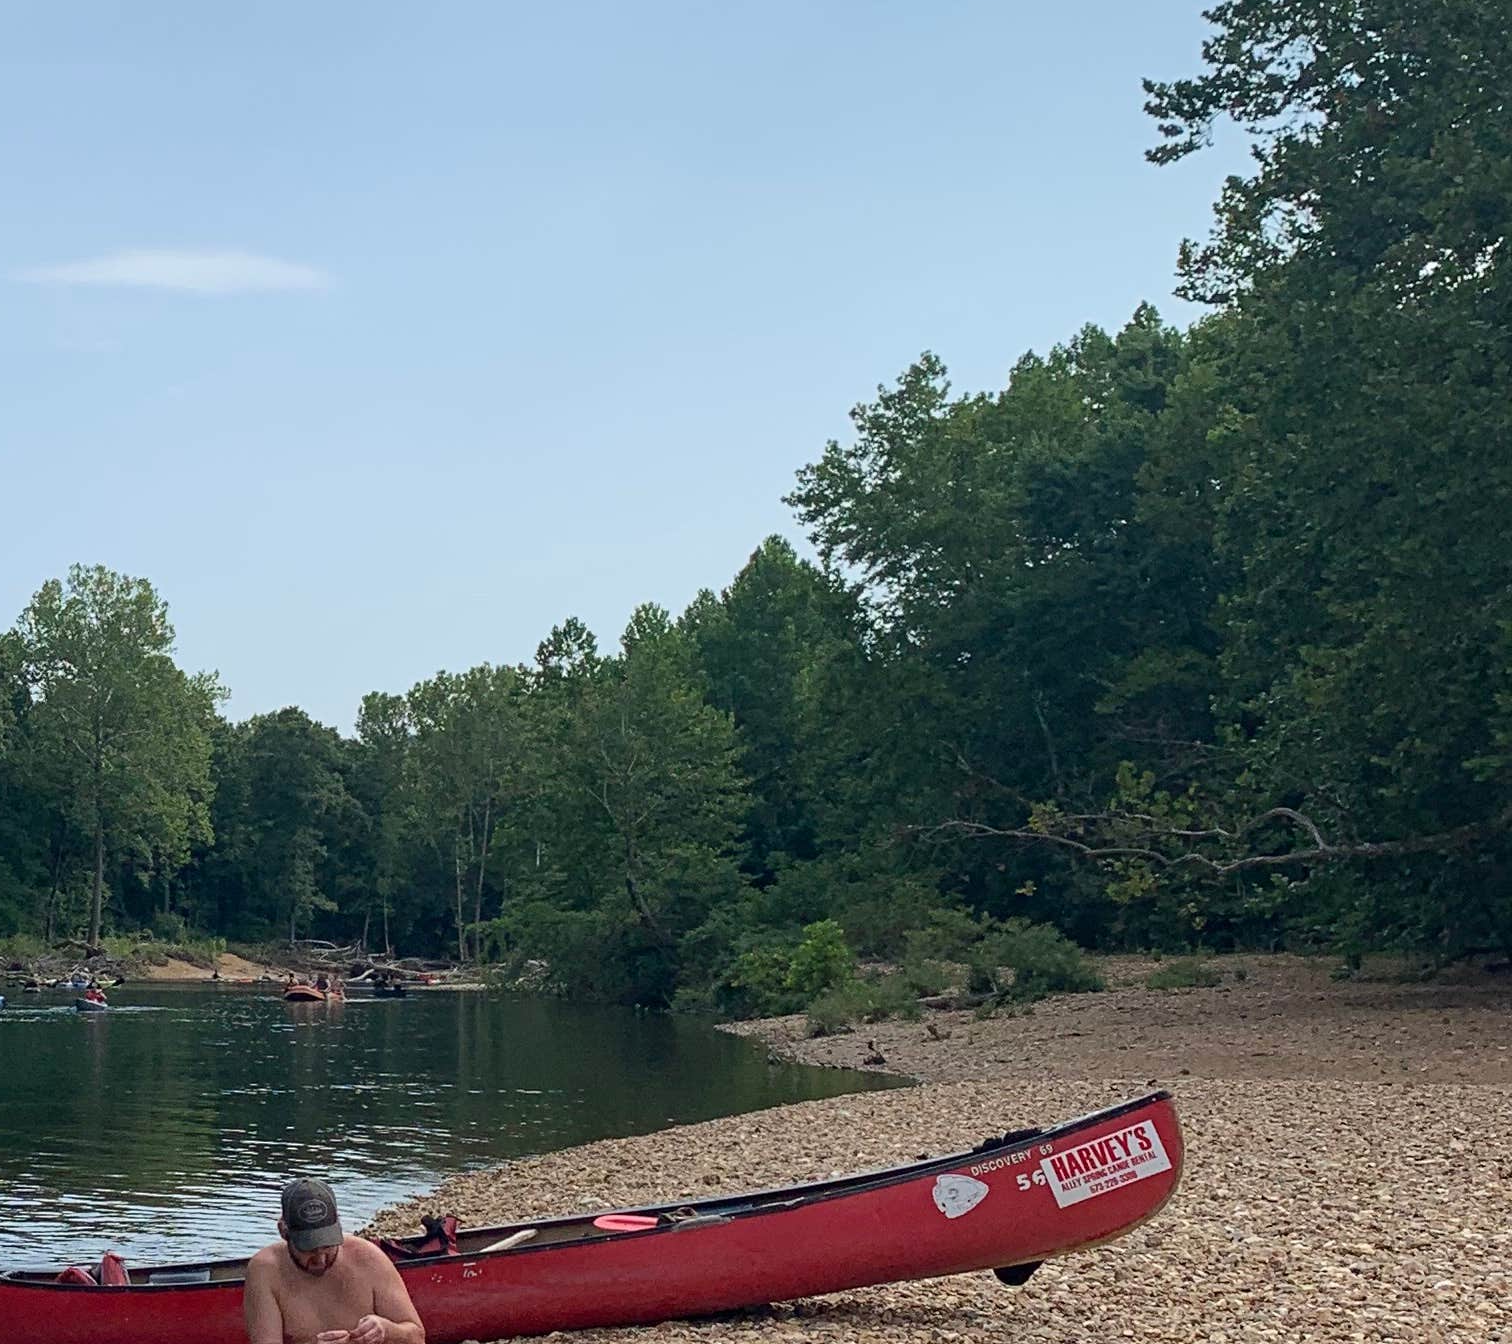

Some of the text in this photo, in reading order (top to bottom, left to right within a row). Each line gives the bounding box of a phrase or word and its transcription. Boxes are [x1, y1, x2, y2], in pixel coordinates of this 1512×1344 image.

[971, 1150, 1031, 1176] DISCOVERY
[1050, 1127, 1152, 1182] HARVEY'S
[1061, 1178, 1081, 1192] ALLEY
[1131, 1151, 1157, 1166] RENTAL
